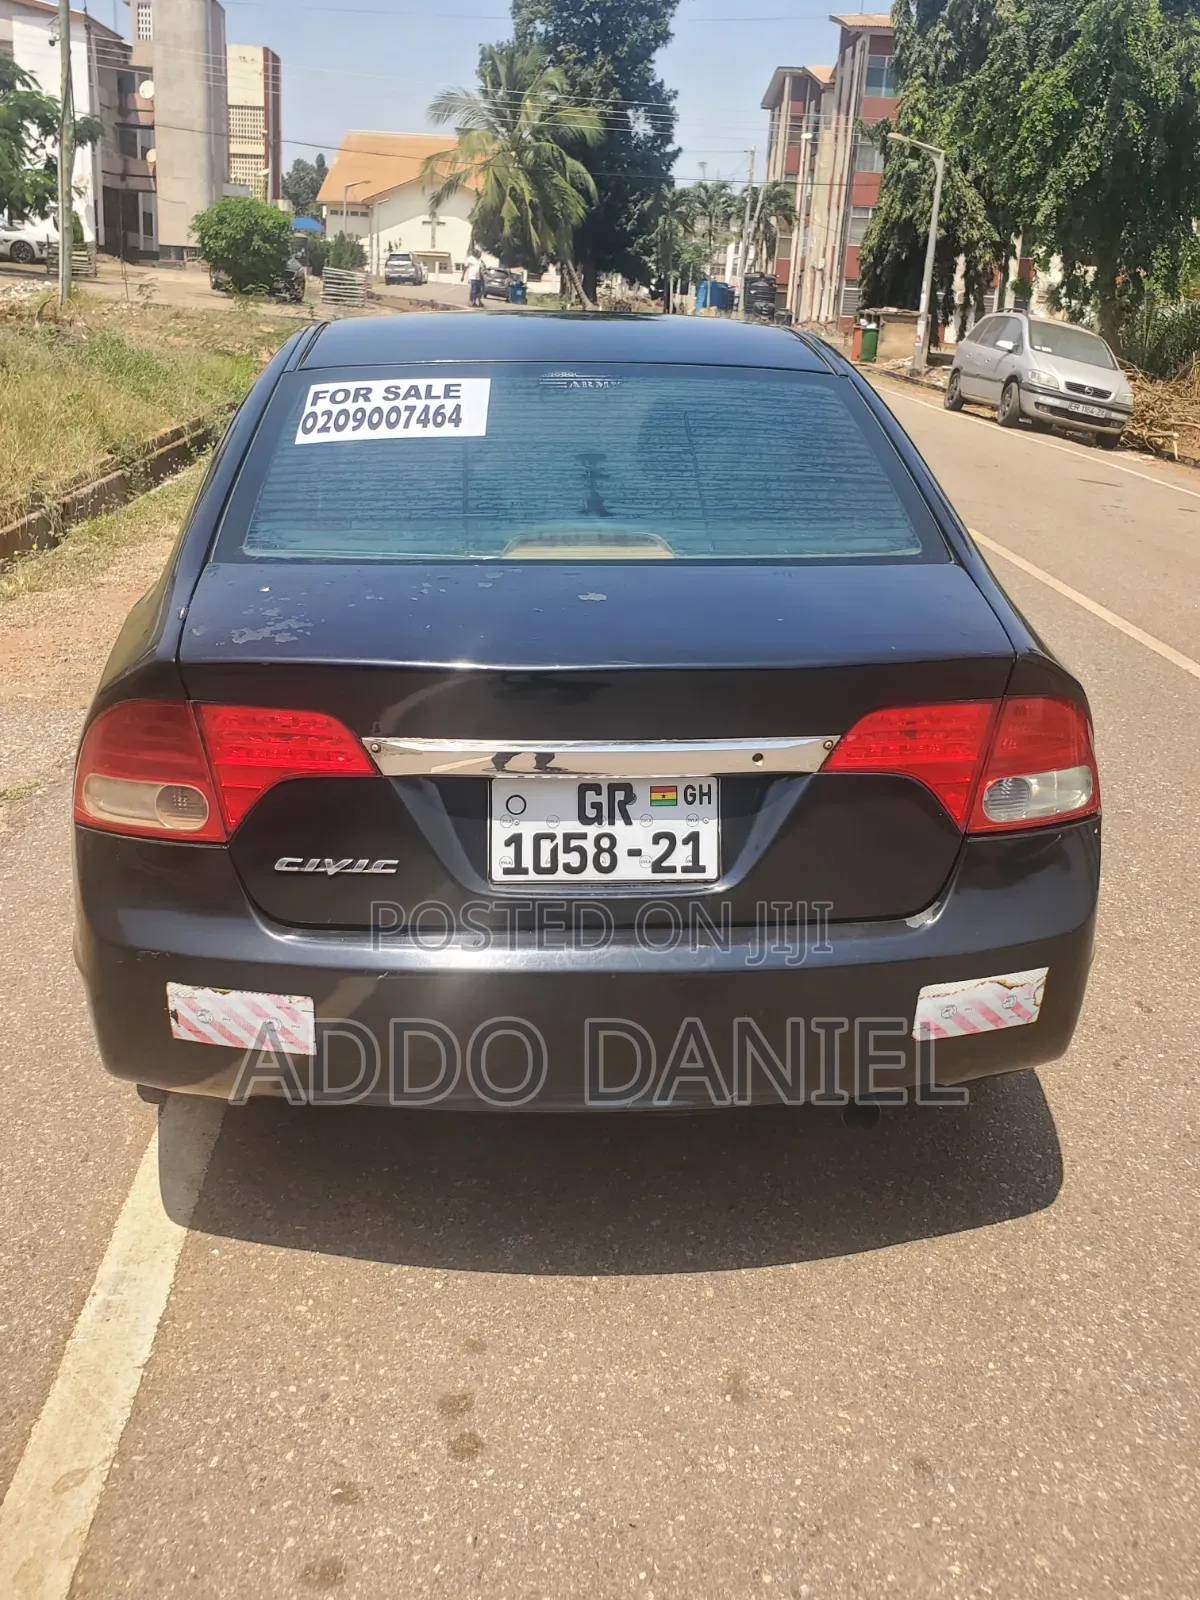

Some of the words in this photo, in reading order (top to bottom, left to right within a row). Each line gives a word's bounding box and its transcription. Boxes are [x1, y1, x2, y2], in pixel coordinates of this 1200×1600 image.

[310, 387, 373, 407] FOR
[382, 384, 462, 401] SALE
[301, 404, 462, 435] 0209007464
[578, 783, 633, 825] GR
[683, 784, 712, 805] GH
[274, 857, 399, 875] CIVIC
[503, 831, 706, 875] 1058-21
